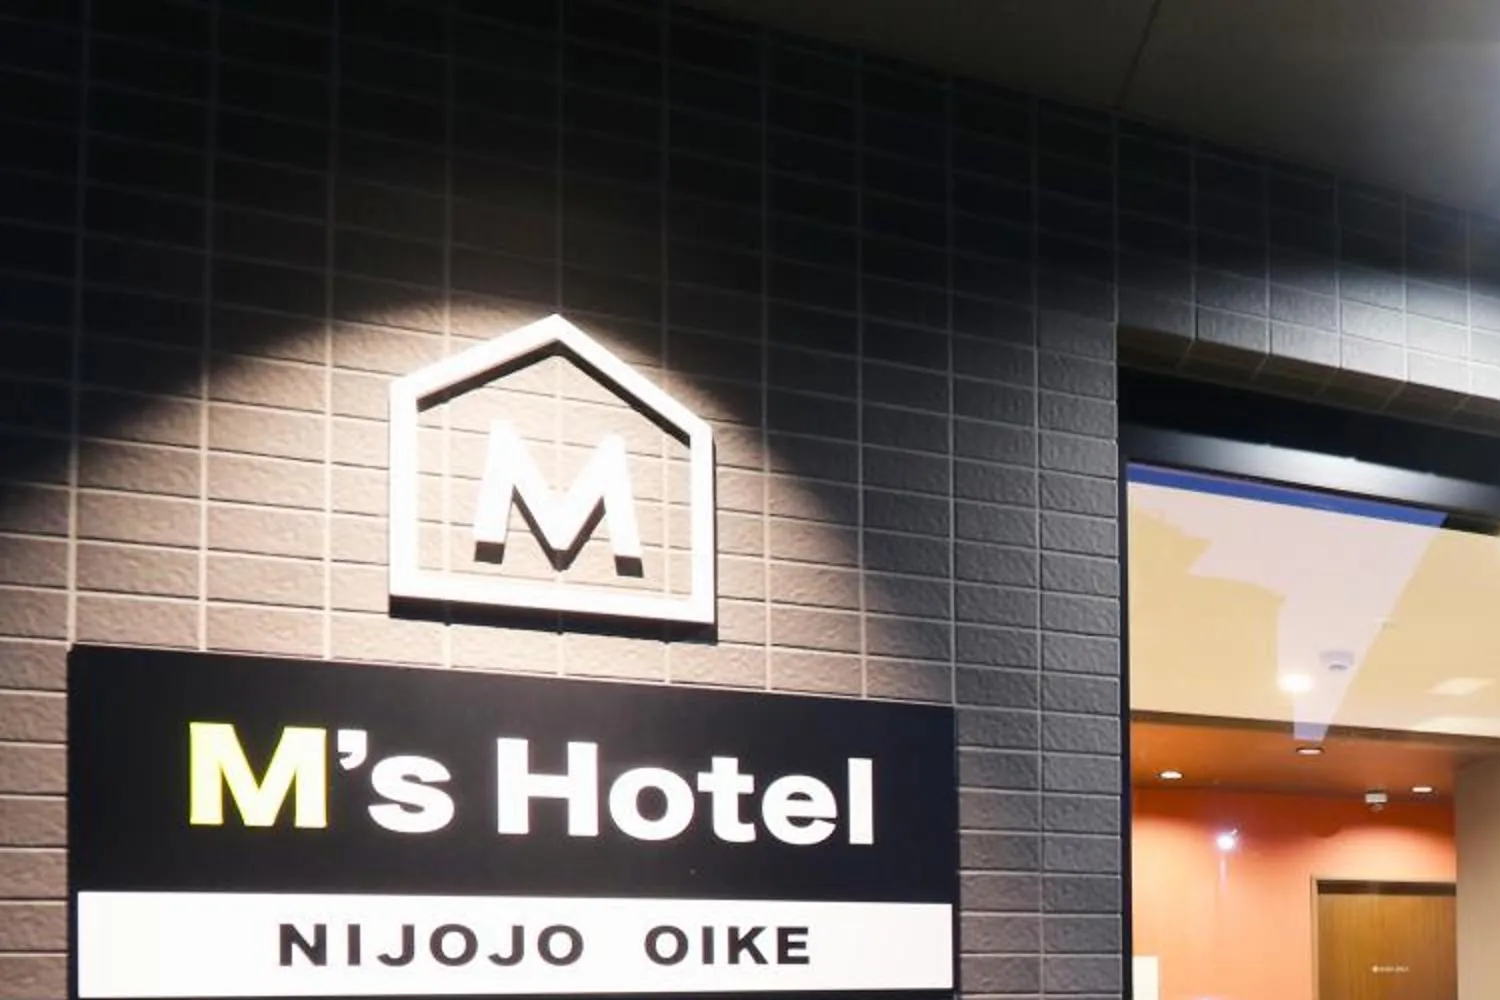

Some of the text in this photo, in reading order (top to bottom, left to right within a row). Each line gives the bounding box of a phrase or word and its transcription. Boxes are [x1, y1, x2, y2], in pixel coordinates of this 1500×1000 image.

[473, 419, 645, 572] M
[189, 721, 874, 846] M's Hotel
[279, 922, 811, 967] NIJOJO OIKE
